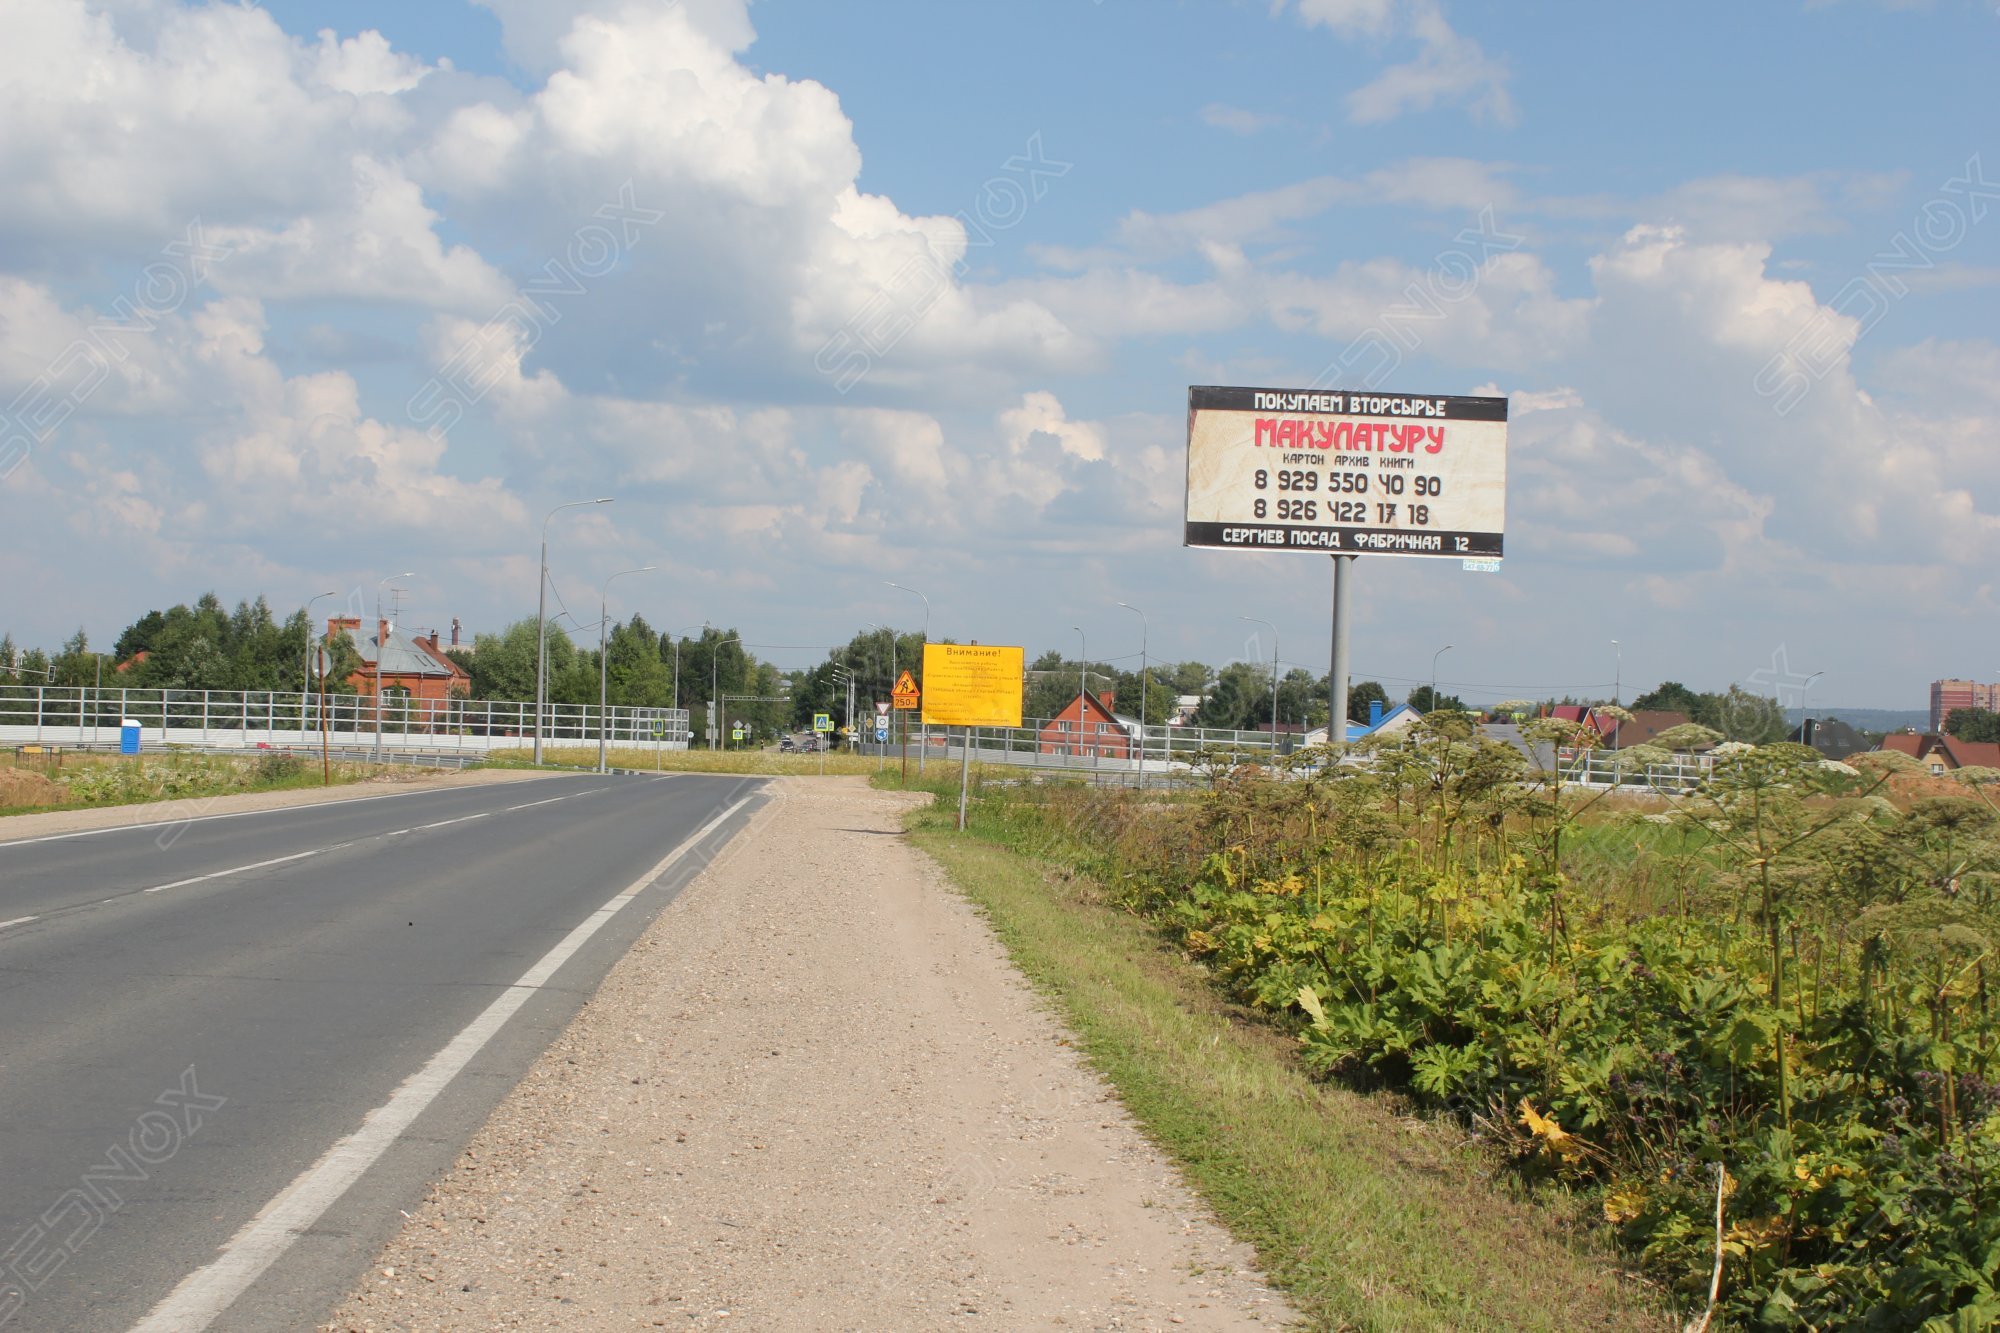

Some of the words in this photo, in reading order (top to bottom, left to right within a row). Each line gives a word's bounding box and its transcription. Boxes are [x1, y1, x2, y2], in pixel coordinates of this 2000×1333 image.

[1254, 392, 1343, 412] ПОКУПАЕМ
[1350, 396, 1446, 417] ВТОРСЫРЬЕ
[1254, 418, 1445, 454] МАКУЛАТУРУ
[1283, 453, 1324, 465] КАРТОН
[1334, 455, 1369, 467] АРХИВ
[1379, 457, 1414, 469] КНИГИ
[1254, 469, 1268, 490] 8
[1277, 470, 1318, 492] 929
[1328, 472, 1368, 494] 550
[1378, 474, 1404, 495] 40
[1414, 475, 1441, 497] 90
[1253, 498, 1267, 519] 8
[1276, 499, 1317, 521] 926
[1327, 501, 1366, 523] 422
[1377, 502, 1397, 524] 17
[1407, 504, 1429, 525] 18
[1222, 527, 1285, 544] СЕРГИЕВ
[1290, 530, 1341, 548] ПОСАД
[1353, 532, 1441, 550] ФАБРИЧНАЯ
[1454, 536, 1470, 551] 12
[946, 647, 1001, 657] Внимание!
